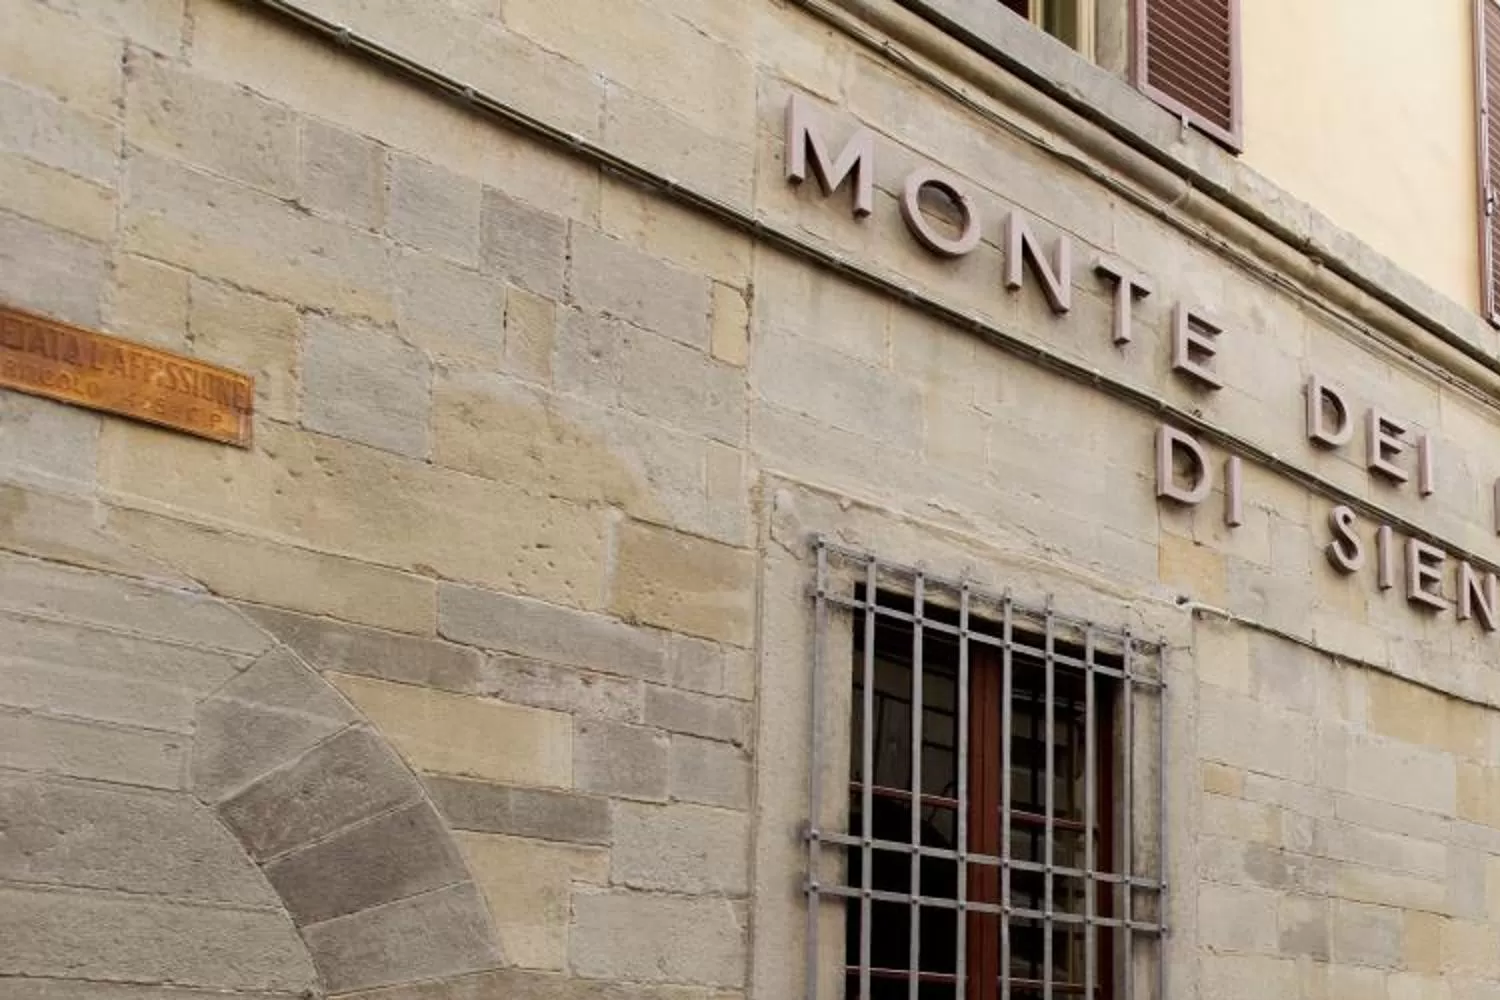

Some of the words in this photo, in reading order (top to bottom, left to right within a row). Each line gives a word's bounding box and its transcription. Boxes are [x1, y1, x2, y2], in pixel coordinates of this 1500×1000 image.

[783, 94, 1223, 390] MONTE
[1305, 374, 1436, 496] DEI
[1156, 424, 1242, 528] DI
